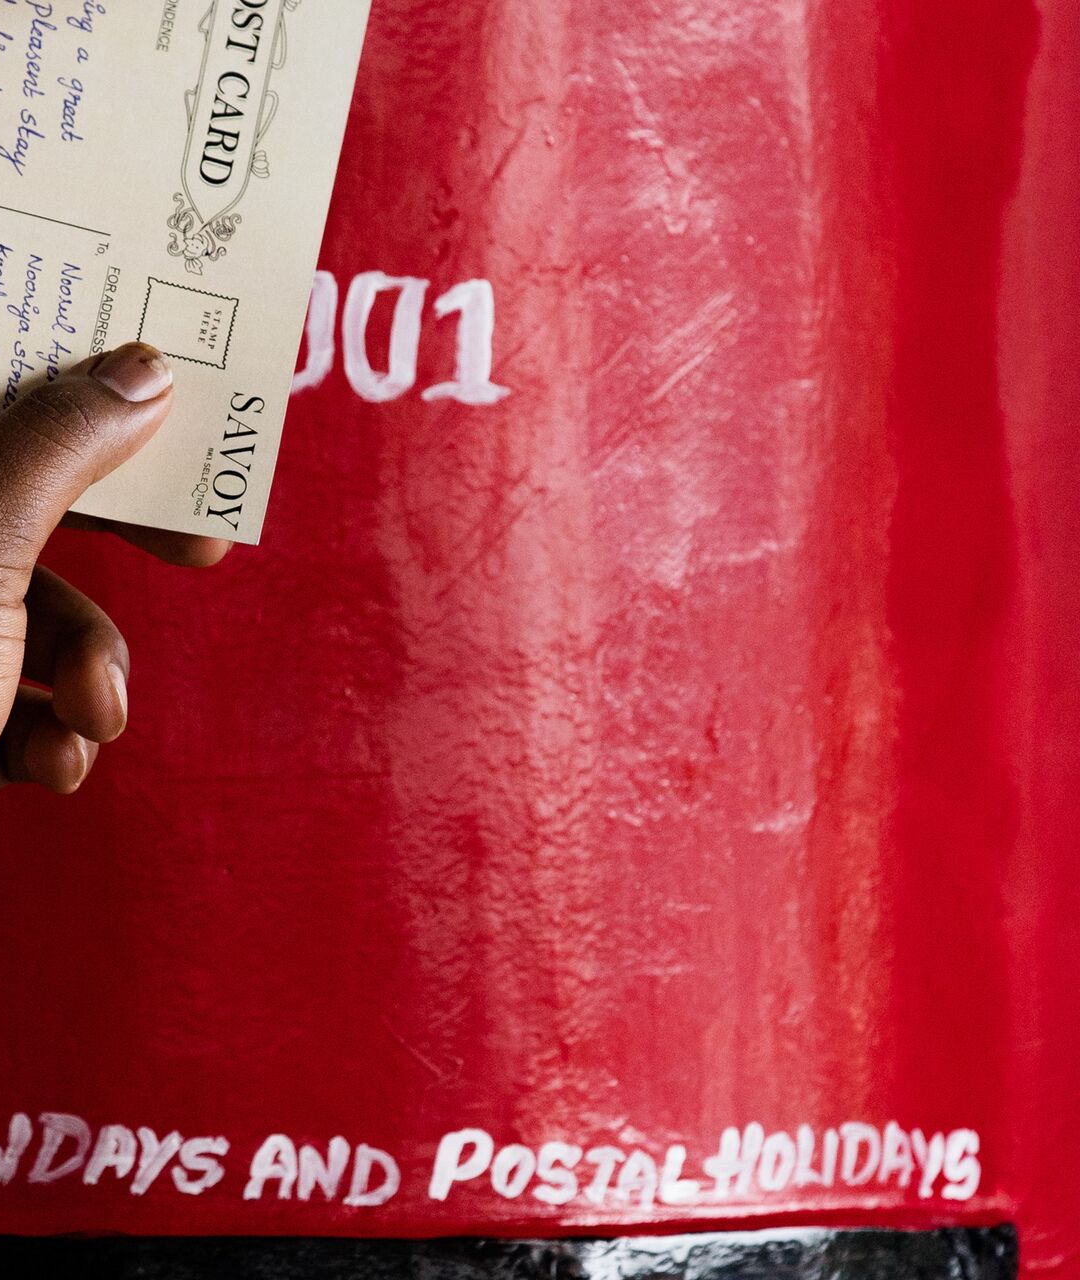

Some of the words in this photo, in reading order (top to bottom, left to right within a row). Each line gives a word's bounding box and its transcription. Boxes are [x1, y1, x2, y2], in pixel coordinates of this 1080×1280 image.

[76, 46, 89, 63] a
[56, 76, 83, 141] great
[198, 70, 250, 185] CARD
[94, 242, 109, 256] To,
[104, 265, 121, 293] FOR
[91, 293, 114, 356] ADDRESS
[197, 310, 211, 341] HERE
[207, 309, 222, 350] STAMP
[205, 391, 265, 531] SAVOY
[243, 1134, 402, 1207] AND
